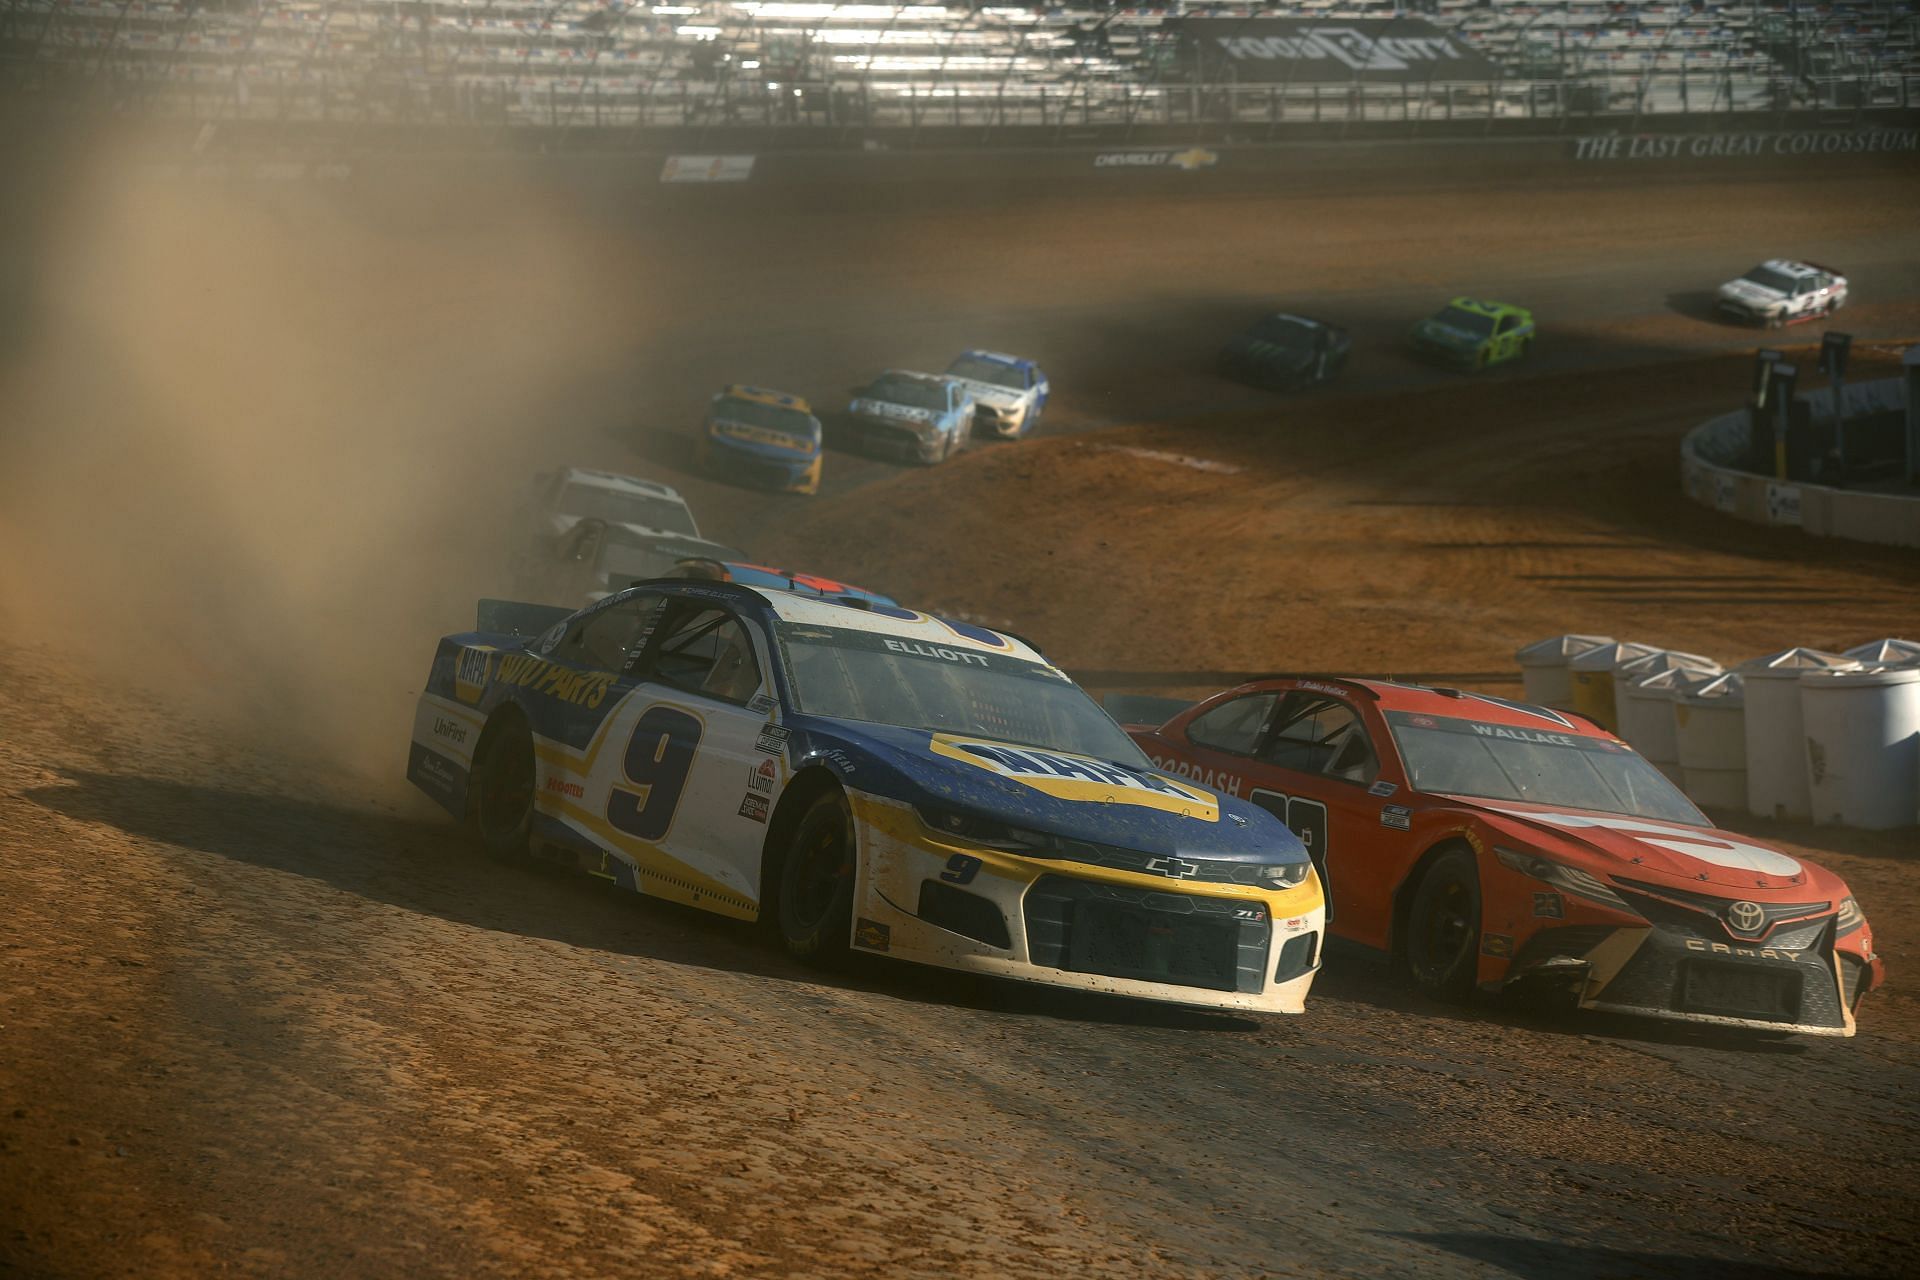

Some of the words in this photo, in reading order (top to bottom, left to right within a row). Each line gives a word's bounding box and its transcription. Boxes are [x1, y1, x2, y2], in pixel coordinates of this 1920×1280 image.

[1576, 136, 1621, 159] THE
[1629, 135, 1682, 158] LAST
[1690, 134, 1768, 156] GREAT
[1773, 131, 1919, 155] COLOSSEUM
[1094, 153, 1168, 167] CHEVROLET
[883, 638, 990, 668] ELLIOTT
[495, 653, 549, 687] AUTO
[531, 664, 621, 710] PARTS
[433, 717, 468, 744] UniFirst
[1470, 724, 1577, 746] WALLACE
[605, 703, 705, 843] 9
[940, 853, 984, 885] 9
[1685, 939, 1801, 962] CAMRY
